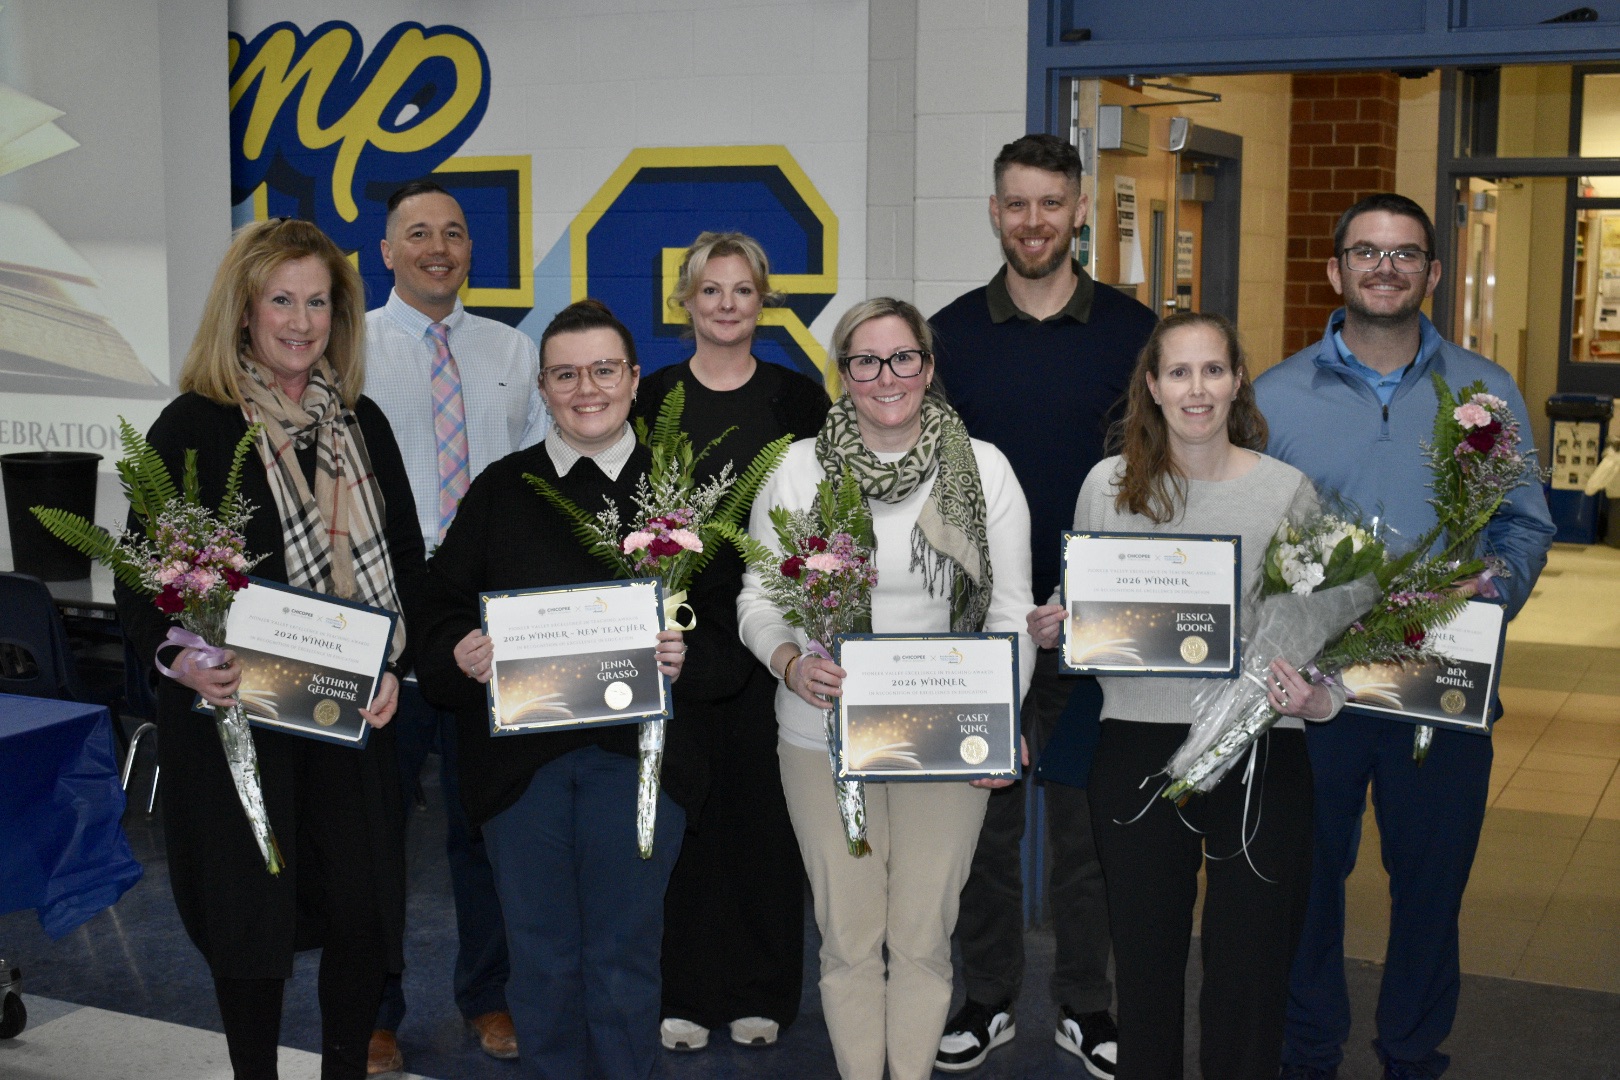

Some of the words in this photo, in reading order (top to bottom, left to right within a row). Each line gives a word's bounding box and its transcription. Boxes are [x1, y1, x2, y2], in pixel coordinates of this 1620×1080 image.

[1145, 576, 1190, 587] WINNER
[1176, 612, 1216, 624] JESSICA
[529, 629, 569, 641] WINNER
[577, 627, 599, 637] NEW
[602, 624, 647, 635] TEACHER
[1176, 623, 1214, 632] BOONE
[274, 629, 298, 641] 2026
[300, 634, 344, 653] WINNER
[600, 659, 635, 672] JENNA
[597, 669, 639, 682] GRASSO
[1447, 667, 1467, 679] BEN
[312, 673, 358, 693] KATHRYN
[921, 677, 967, 687] WINNER
[1435, 676, 1474, 689] BOHLKE
[307, 684, 357, 702] GELONESE
[957, 713, 989, 722] CASEY
[960, 724, 988, 734] KING
